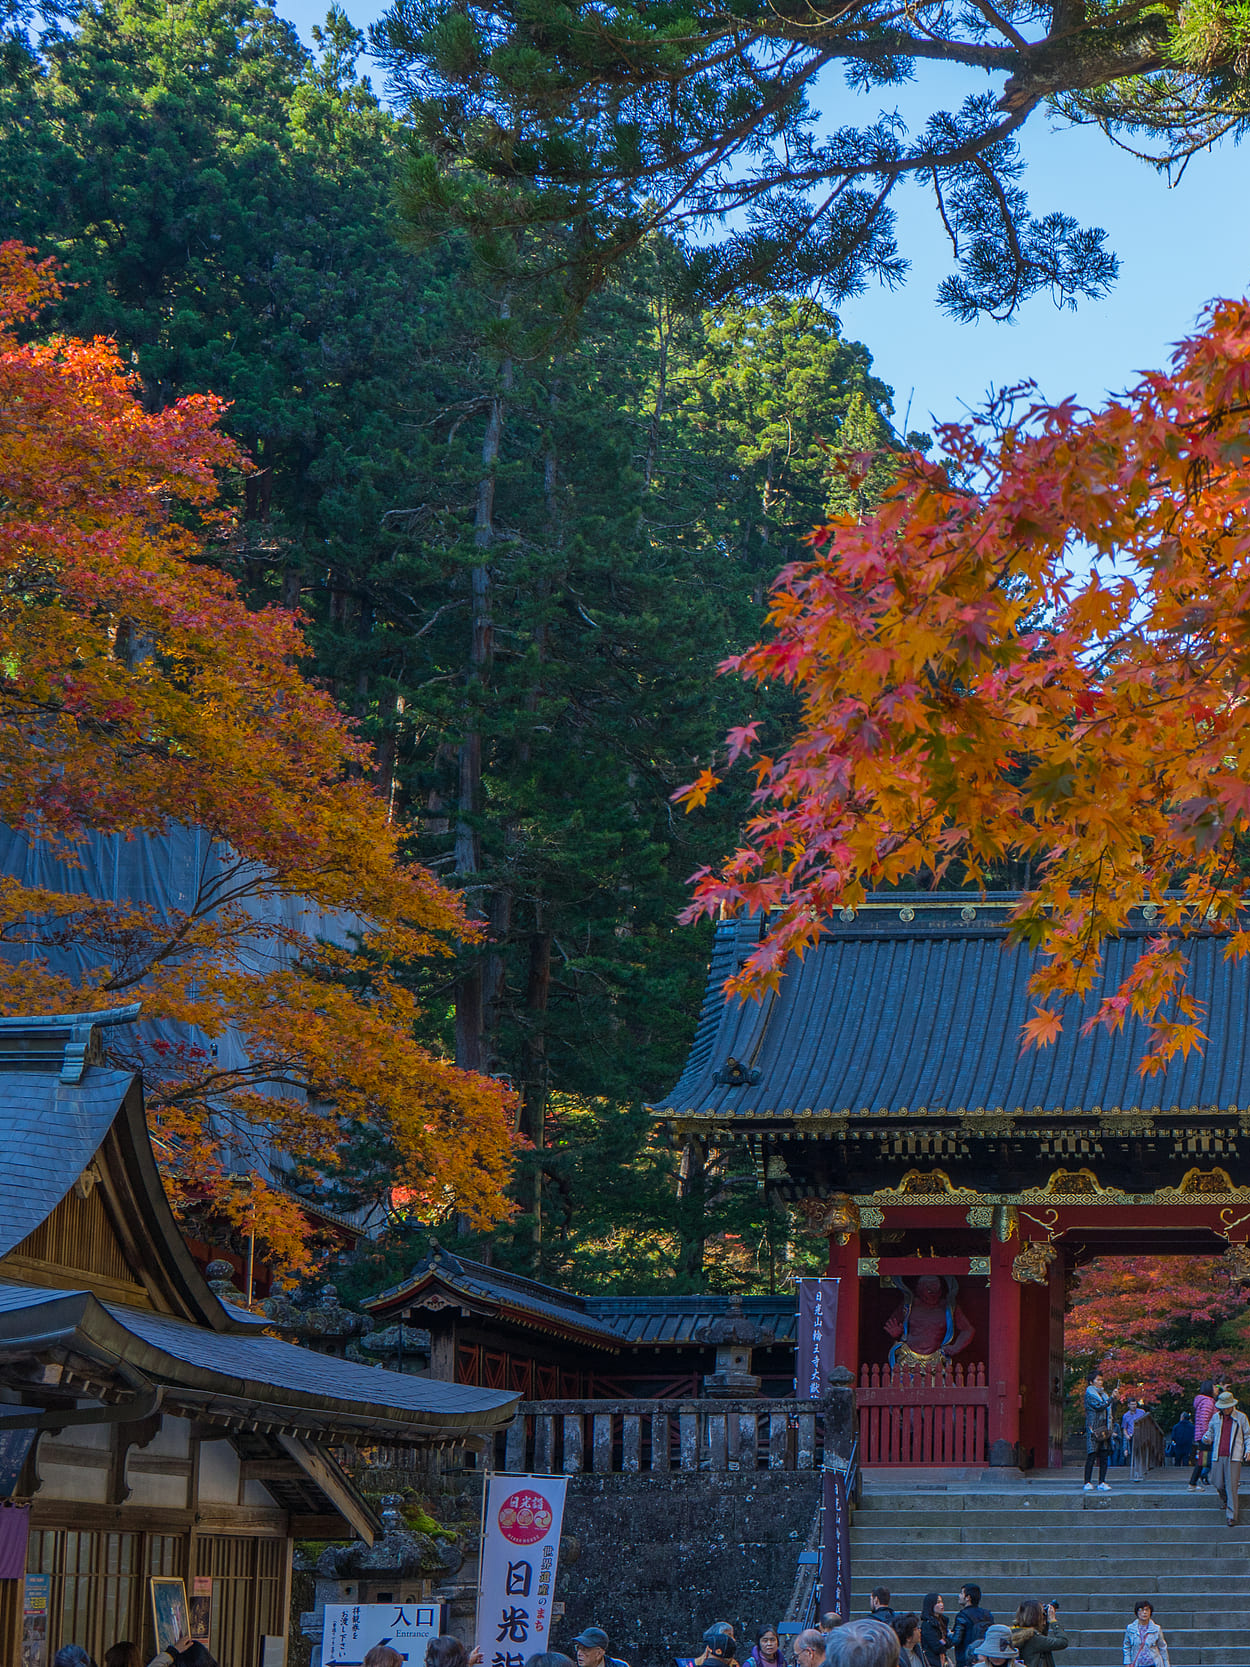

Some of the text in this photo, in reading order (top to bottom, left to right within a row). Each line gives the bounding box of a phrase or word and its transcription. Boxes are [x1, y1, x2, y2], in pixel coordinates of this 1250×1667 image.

[509, 1495, 545, 1510] 日光詣
[535, 1545, 554, 1633] 世界遺産のまち
[390, 1606, 435, 1628] 入口
[396, 1629, 430, 1638] Entrance
